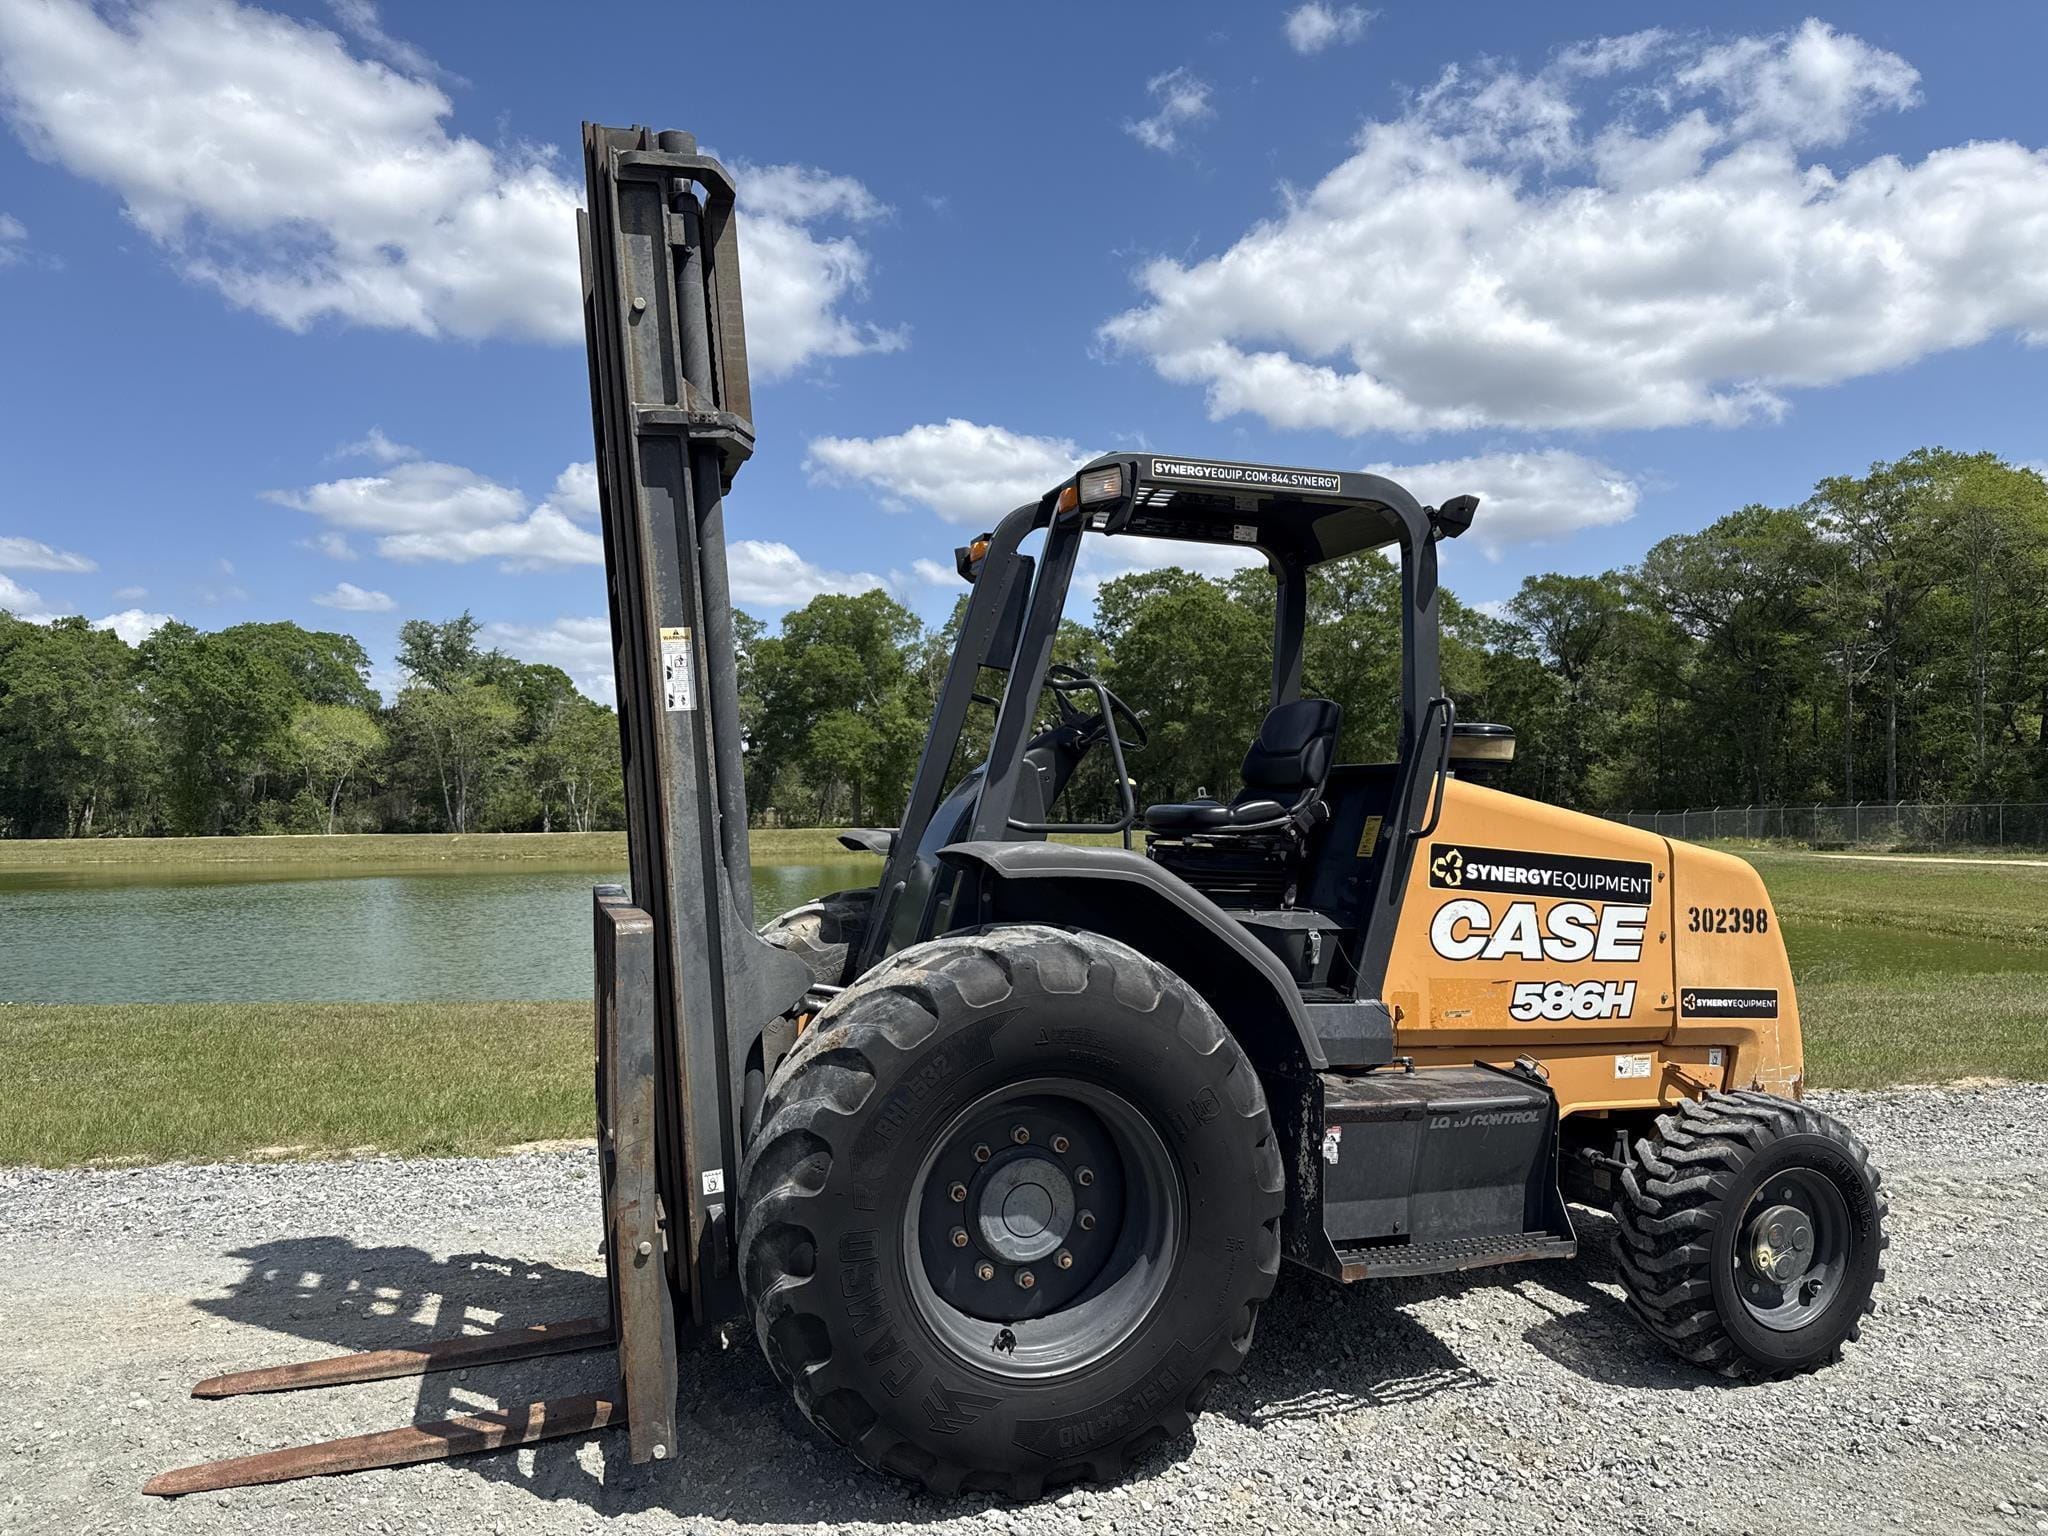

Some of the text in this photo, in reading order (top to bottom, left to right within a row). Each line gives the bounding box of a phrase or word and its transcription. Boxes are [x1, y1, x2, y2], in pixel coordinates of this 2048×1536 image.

[1465, 862, 1652, 895] SYNERGYEQUIPMENT
[1429, 898, 1649, 962] CASE
[1687, 906, 1768, 934] 302398
[1509, 980, 1638, 1022] 586H
[1696, 998, 1777, 1009] SYNERGYEQUIPMENT
[839, 1229, 924, 1397] CAMSO
